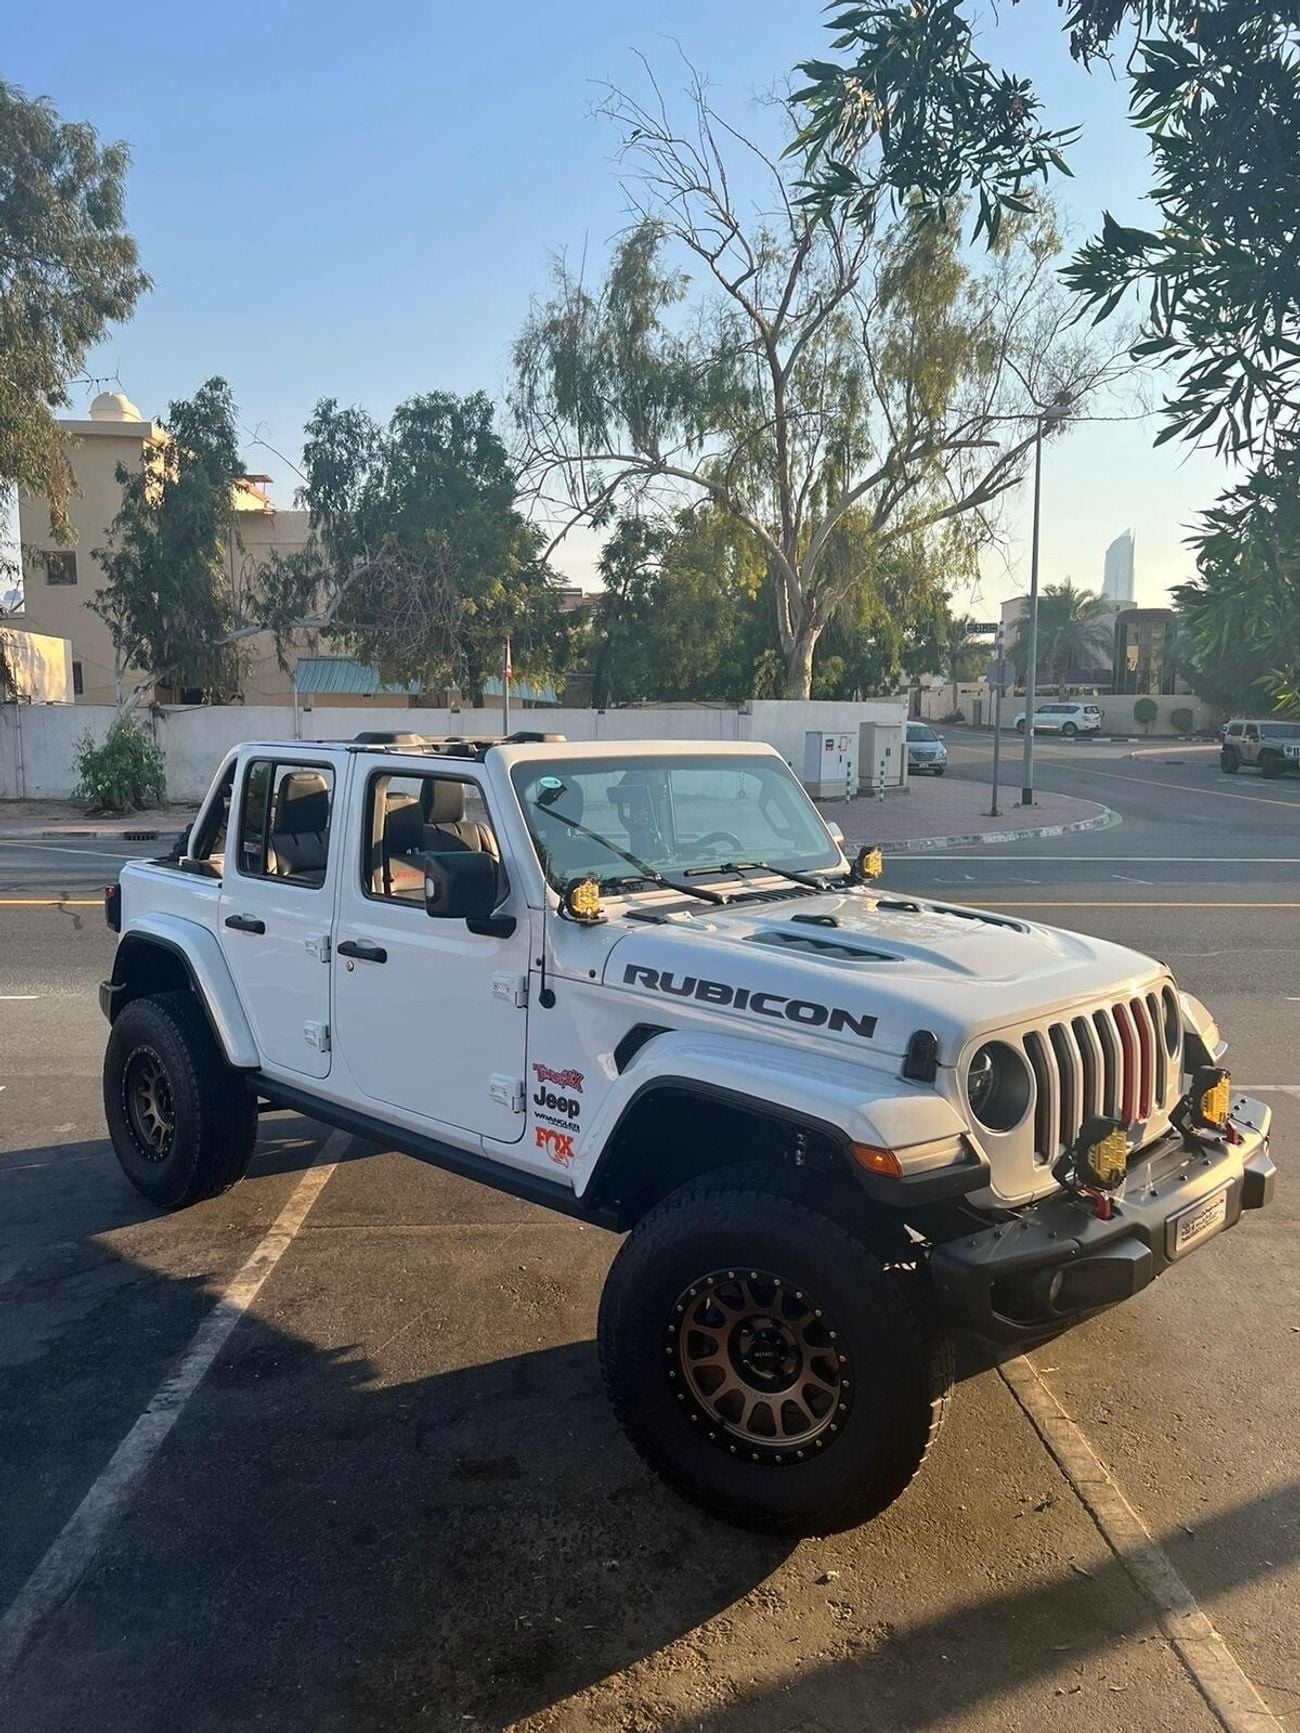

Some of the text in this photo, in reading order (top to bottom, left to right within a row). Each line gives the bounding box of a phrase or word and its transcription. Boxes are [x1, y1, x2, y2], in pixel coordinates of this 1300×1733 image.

[623, 963, 878, 1039] RUBICON
[533, 1086, 580, 1119] Jeep
[534, 1110, 580, 1131] WRANGLER
[535, 1126, 574, 1165] FOX
